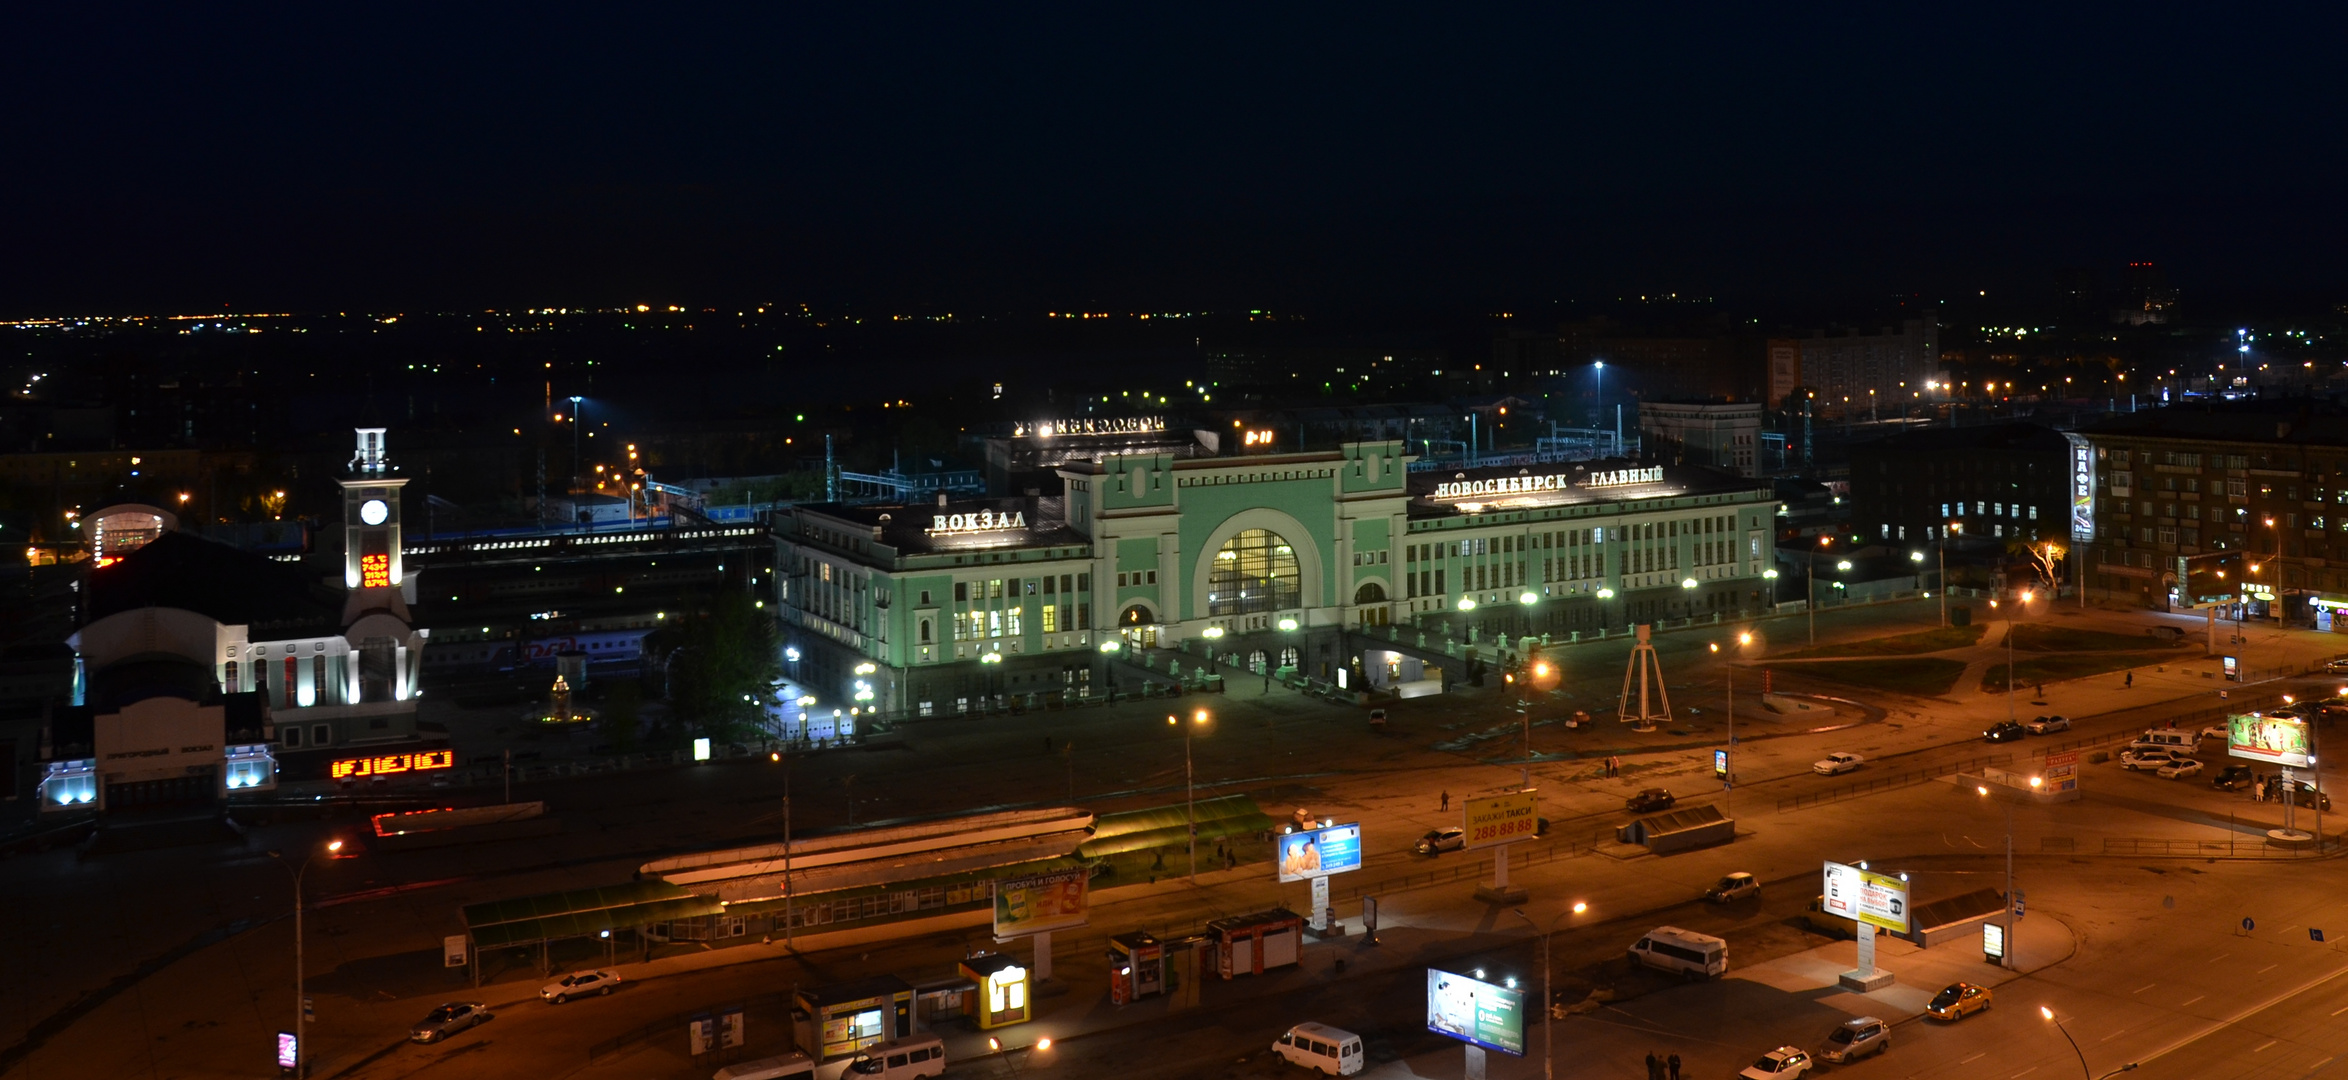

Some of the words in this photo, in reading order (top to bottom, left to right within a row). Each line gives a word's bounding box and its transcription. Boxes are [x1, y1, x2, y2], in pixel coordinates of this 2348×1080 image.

[1436, 474, 1567, 498] НОВОСИБИРСК
[1591, 465, 1664, 486] ГЛАВНЫЙ
[2076, 449, 2089, 496] КАФЕ
[933, 511, 1026, 531] ВОКЗАЛ
[107, 747, 169, 760] ПРИГОРОДНЫЙ
[181, 744, 214, 754] ВОКЗАЛ
[1473, 811, 1505, 825] ЗАКАЖИ
[1505, 806, 1532, 818] ТАКСИ
[1006, 879, 1036, 891] ПРОБУЙ
[1037, 878, 1044, 886] И
[1045, 872, 1081, 885] ГОЛОСУЙ
